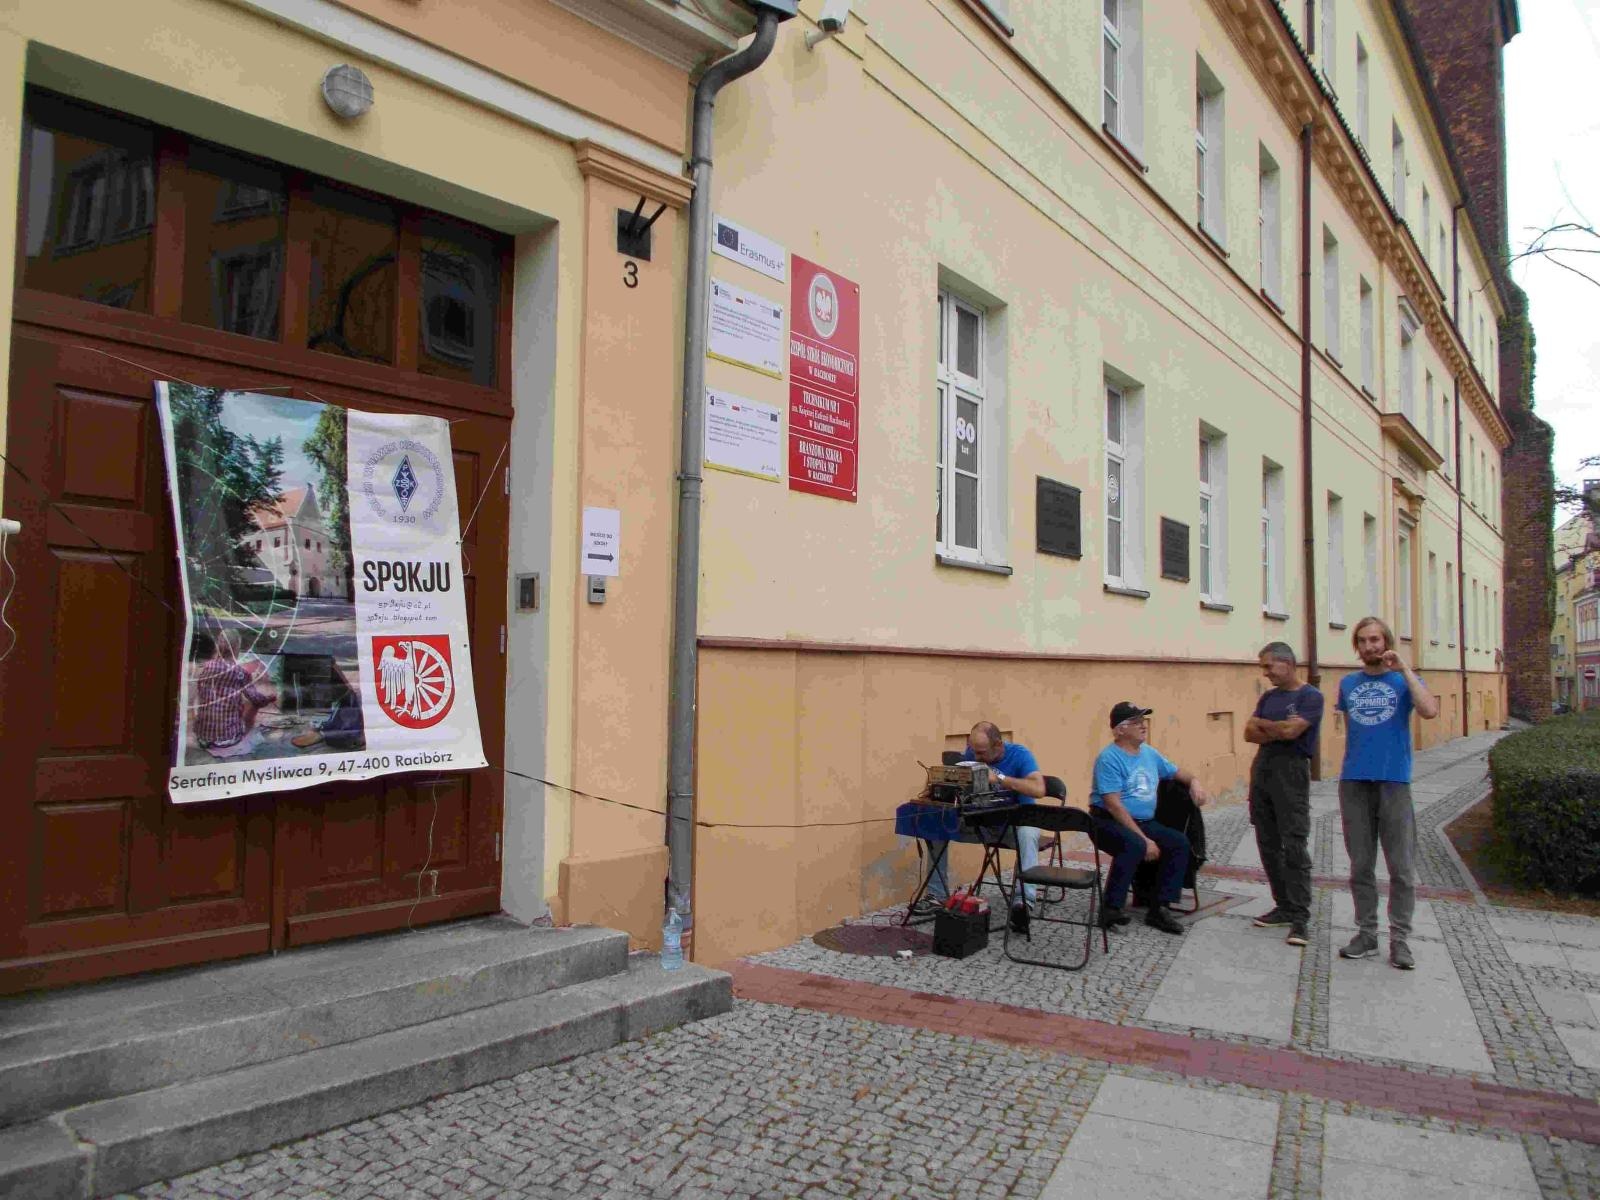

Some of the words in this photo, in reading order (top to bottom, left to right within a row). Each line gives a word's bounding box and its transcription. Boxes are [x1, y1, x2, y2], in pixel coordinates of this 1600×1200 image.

[623, 260, 638, 288] 3
[956, 416, 975, 443] 80
[392, 515, 416, 524] 1930
[362, 560, 451, 593] SP9KJU
[170, 772, 237, 790] Serafina
[242, 766, 313, 785] Myśliwca
[318, 762, 333, 776] 9,
[337, 755, 391, 773] 47-400
[395, 751, 453, 767] Racibórz
